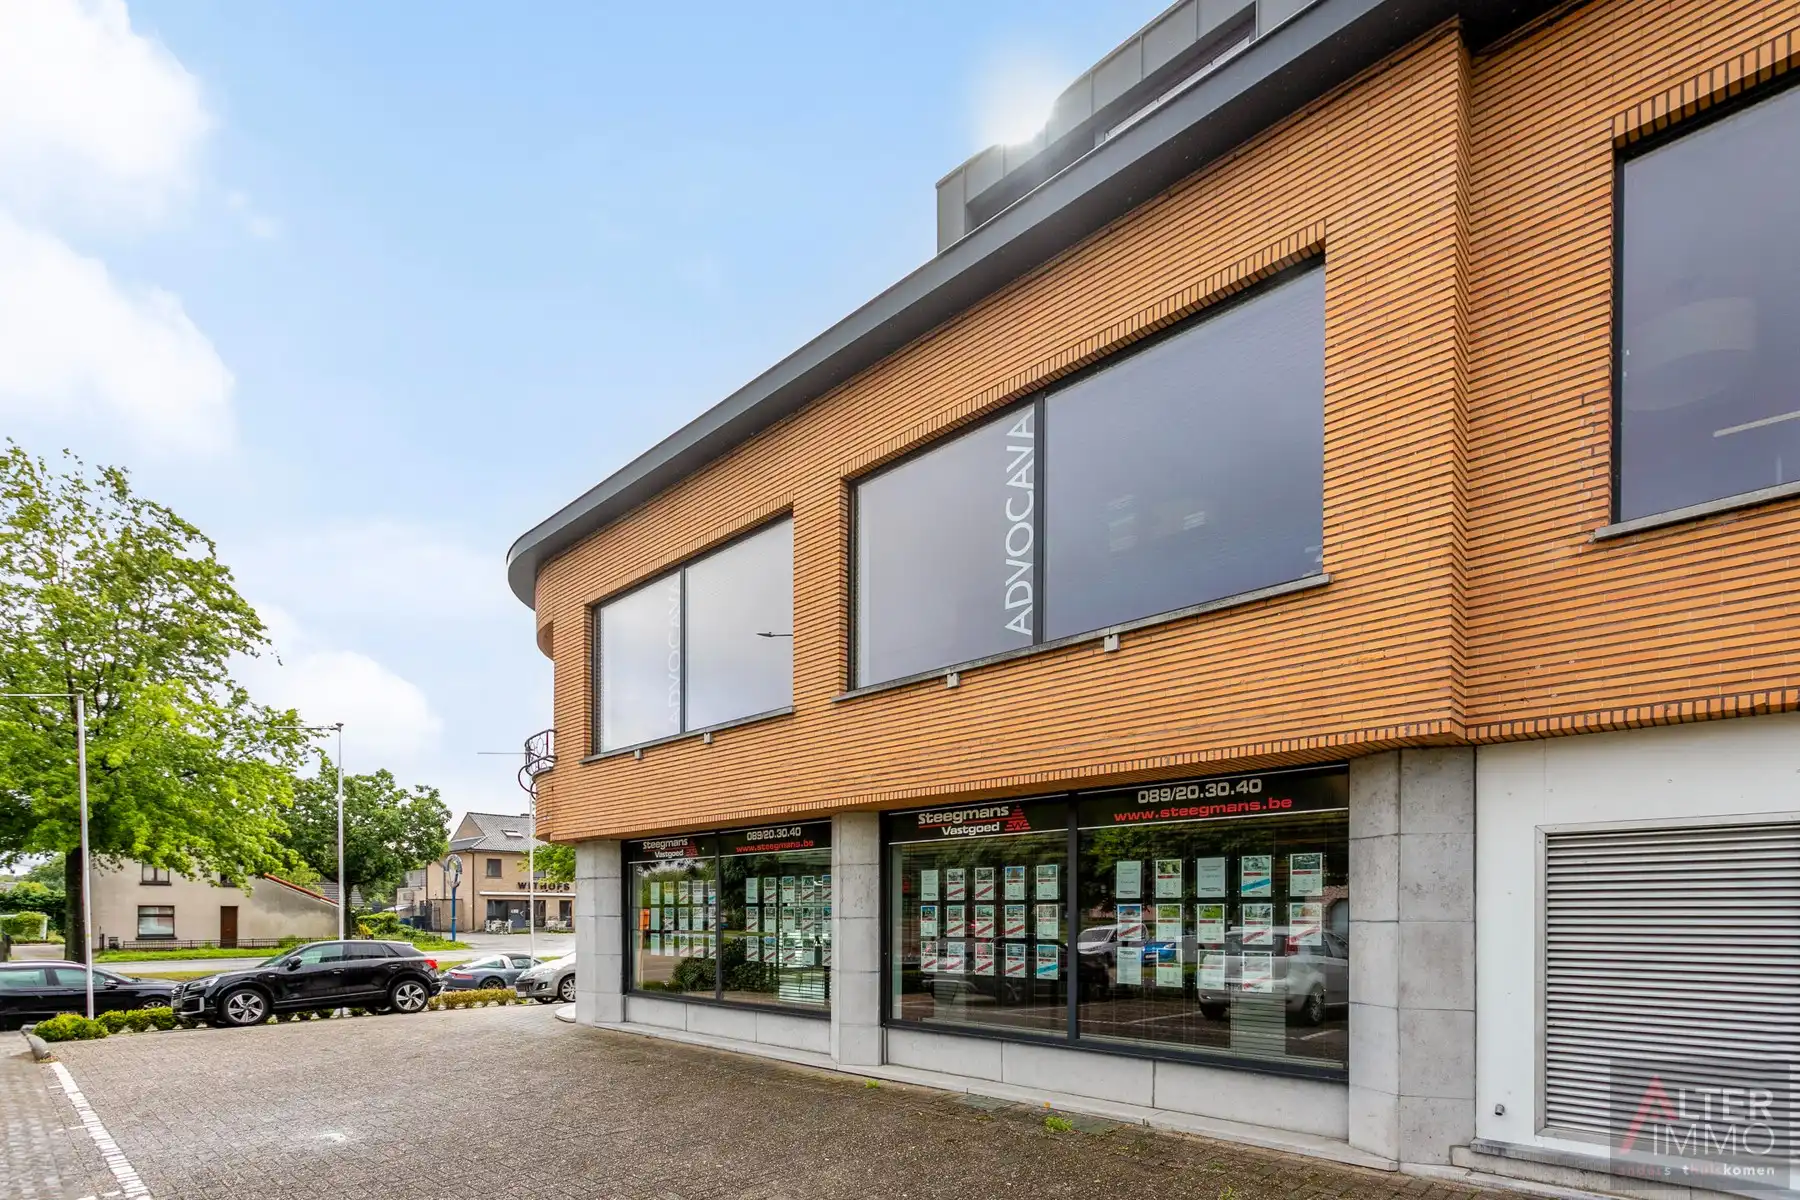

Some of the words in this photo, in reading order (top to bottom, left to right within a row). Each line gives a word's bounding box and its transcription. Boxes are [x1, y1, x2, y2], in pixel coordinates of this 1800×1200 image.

[1137, 778, 1262, 804] 089/20.30.40
[918, 805, 1010, 825] Steegmans
[1113, 797, 1293, 822] www.steegmans.be
[746, 826, 802, 841] 089/20.30.40
[941, 822, 1000, 836] Vastgoed
[642, 838, 689, 850] Steegmans
[735, 839, 814, 854] www.steegmans.be
[654, 849, 684, 859] Vastgoed
